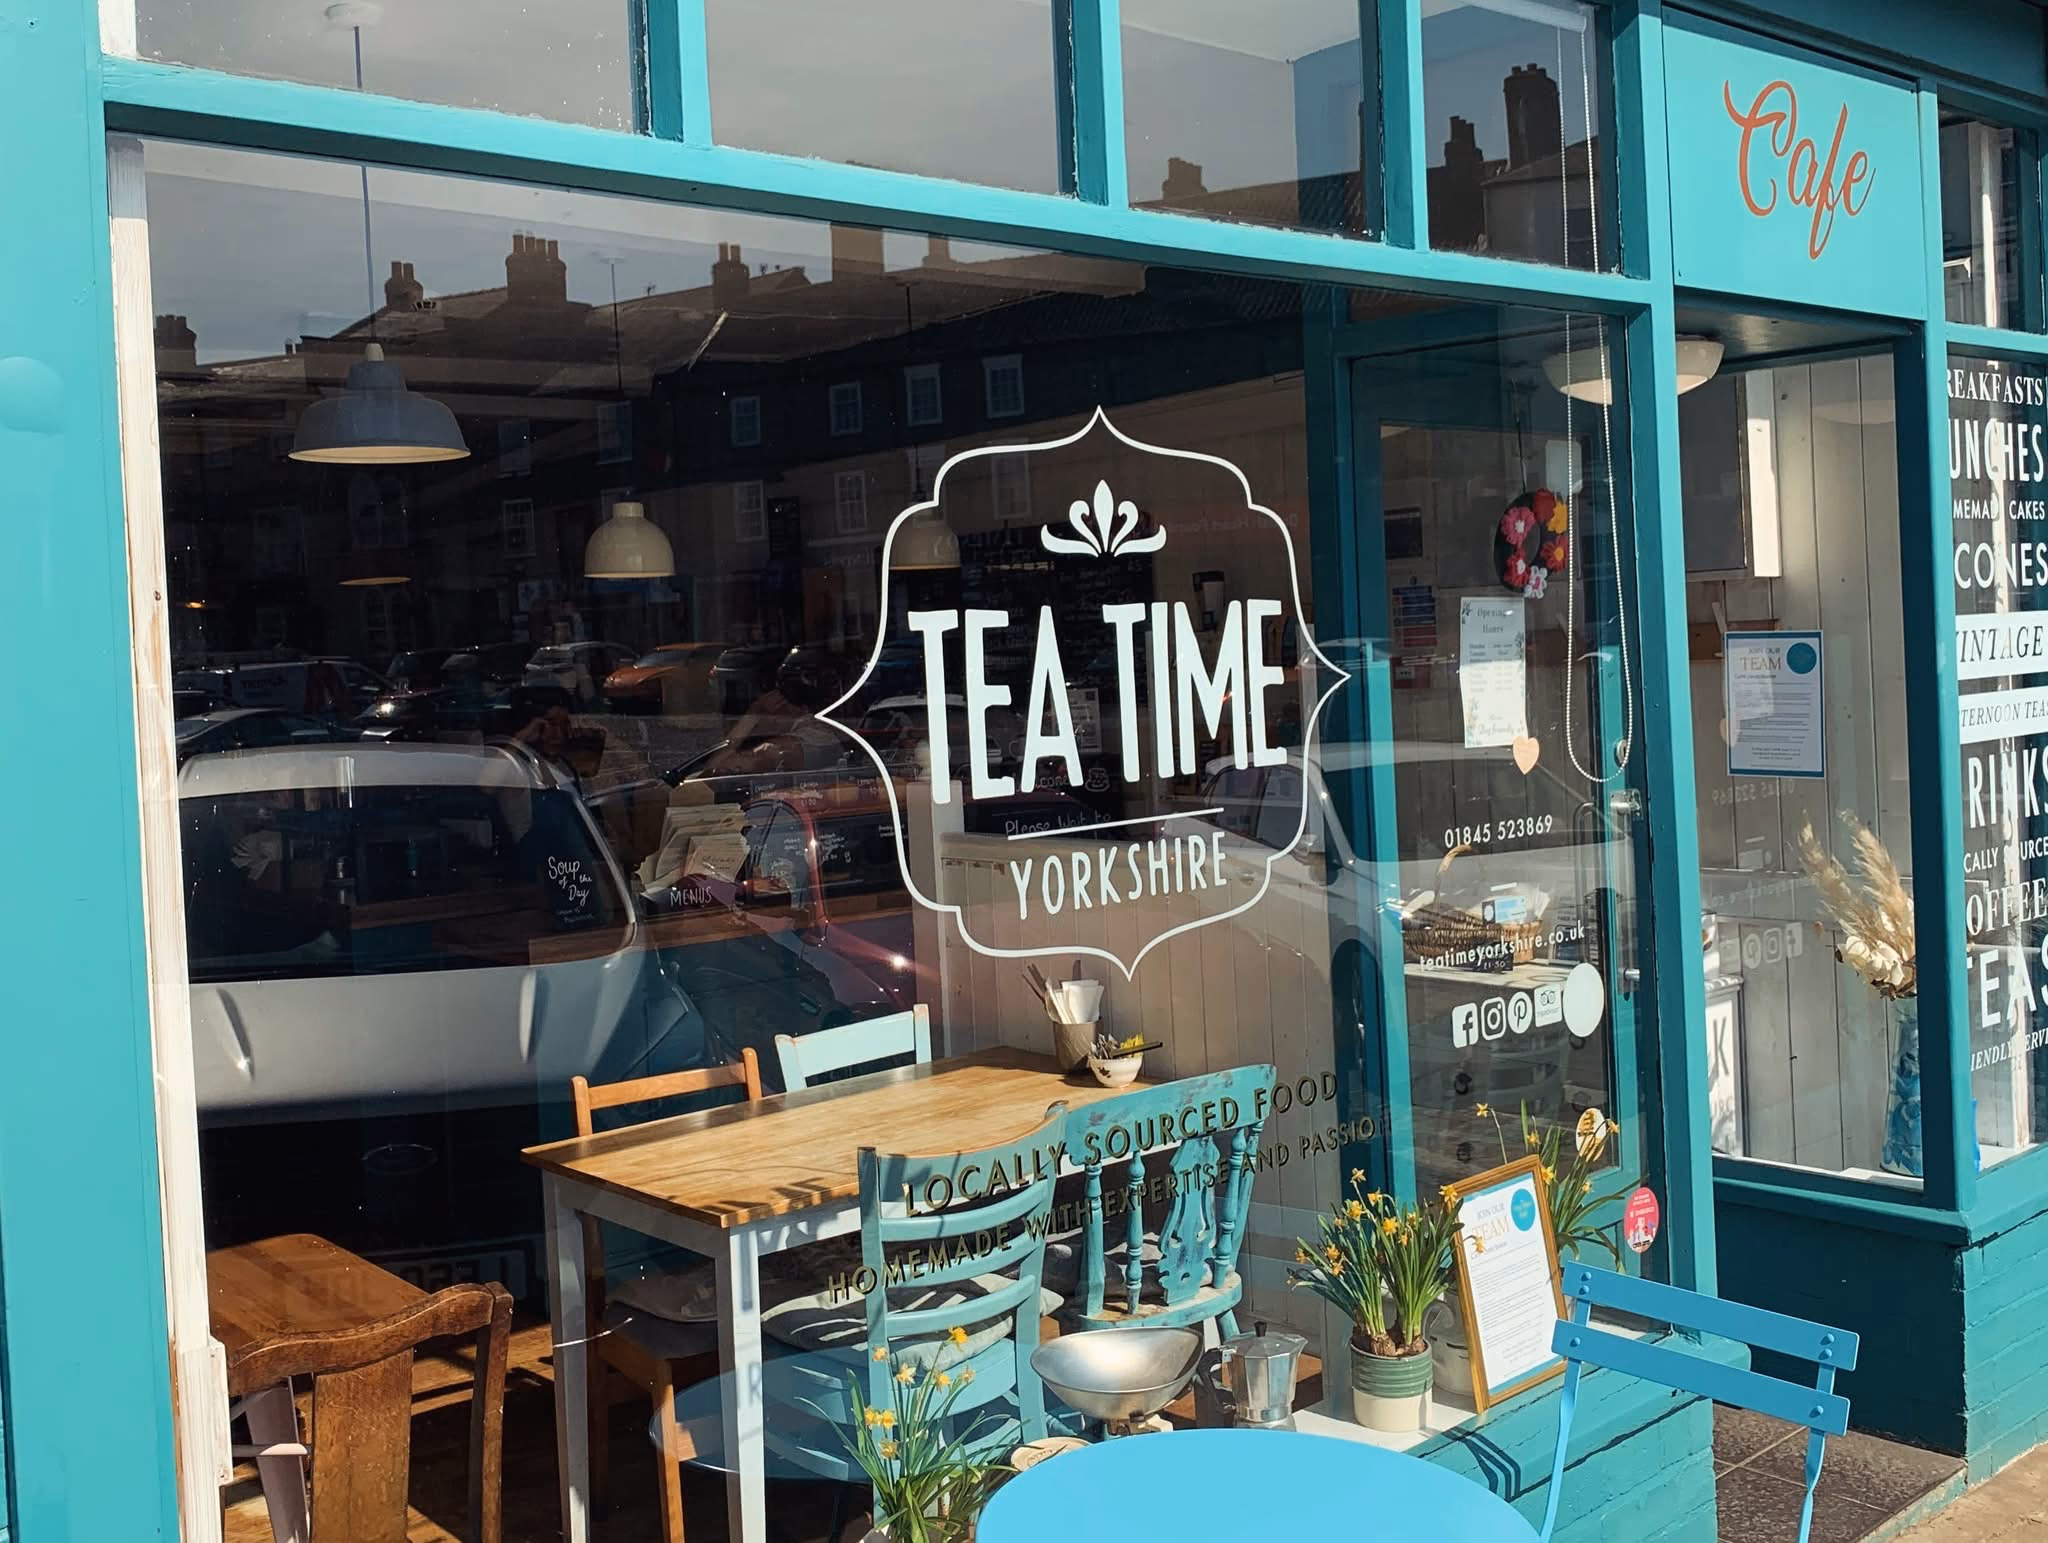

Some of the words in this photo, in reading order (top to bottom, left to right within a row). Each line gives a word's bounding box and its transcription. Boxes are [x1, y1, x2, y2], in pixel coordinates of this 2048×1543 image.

[1723, 79, 1877, 260] Cafe
[1953, 497, 2002, 520] MEMAD
[2009, 500, 2046, 521] CAKES
[1956, 627, 2044, 663] INTAGE
[1740, 657, 1782, 671] TEAM
[907, 604, 1084, 804] TEA
[1102, 599, 1288, 782] TIME
[2025, 699, 2048, 719] TEA
[1444, 823, 1491, 849] 01845
[1497, 814, 1553, 841] 523869
[547, 855, 581, 880] Soup
[558, 875, 569, 889] of
[579, 873, 593, 884] the
[1010, 831, 1227, 921] YORKSHIRE
[568, 884, 591, 907] Day
[670, 886, 712, 908] MENUS
[1420, 919, 1585, 973] teatimeyorkshire.co.uk
[902, 1139, 1068, 1219] LOCALLY
[1083, 1094, 1242, 1166] SOURCED
[1253, 1070, 1339, 1121] FOOD
[826, 1226, 1013, 1305] HOMEMADE
[1025, 1197, 1096, 1243] WITH
[1103, 1156, 1232, 1218] EXPERTISE
[1240, 1142, 1291, 1177] AND
[1472, 1215, 1510, 1241] TEAM
